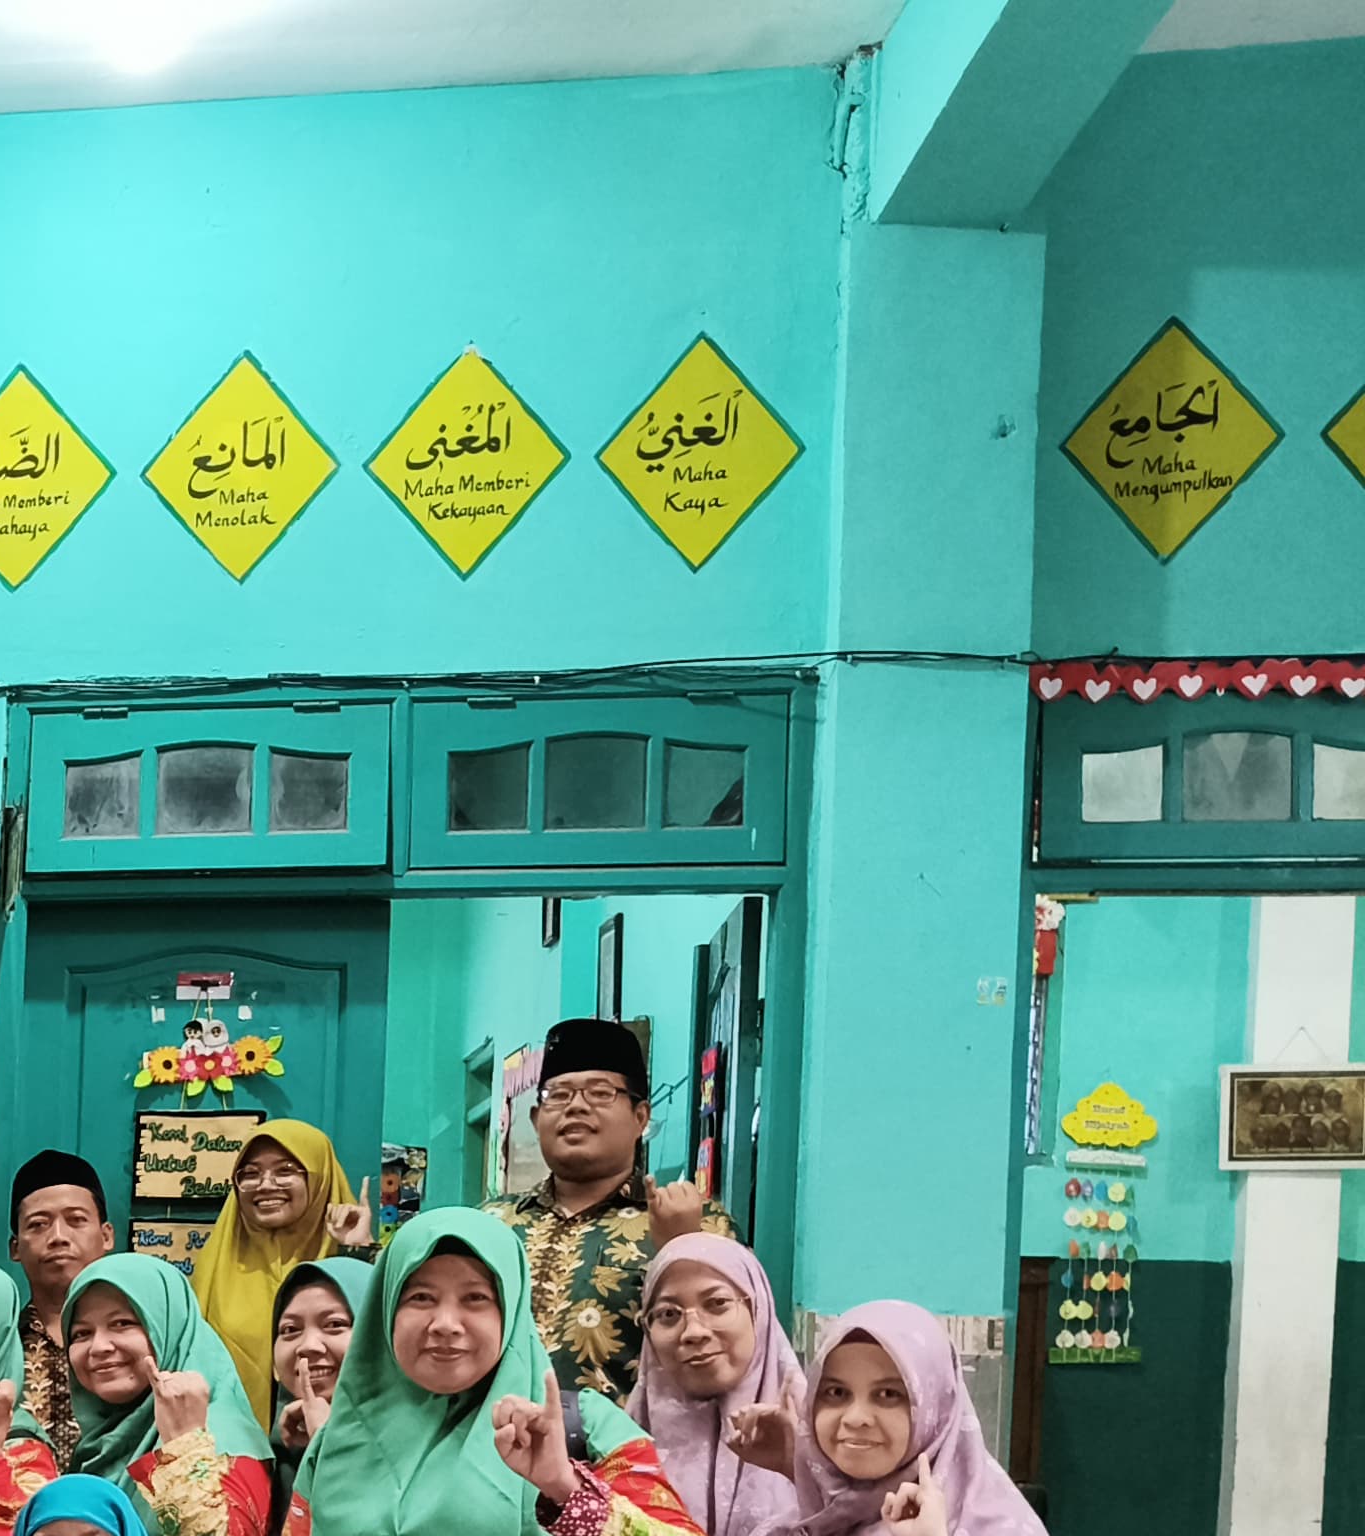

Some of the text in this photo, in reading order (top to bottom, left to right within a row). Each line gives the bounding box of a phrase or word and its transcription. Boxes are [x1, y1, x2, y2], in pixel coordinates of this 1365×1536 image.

[673, 461, 728, 485] Maha
[1141, 451, 1197, 476] Maha
[218, 485, 269, 505] Maha
[404, 470, 531, 501] Maha Memberi
[1114, 469, 1234, 504] Mengumpulkan
[3, 489, 70, 509] Memberi
[663, 491, 729, 518] Kaya
[195, 508, 278, 529] Menolak
[427, 501, 510, 526] Kekayaan
[149, 1122, 243, 1151] Kami Datan
[141, 1153, 197, 1173] Untuk
[180, 1176, 234, 1197] Belaj
